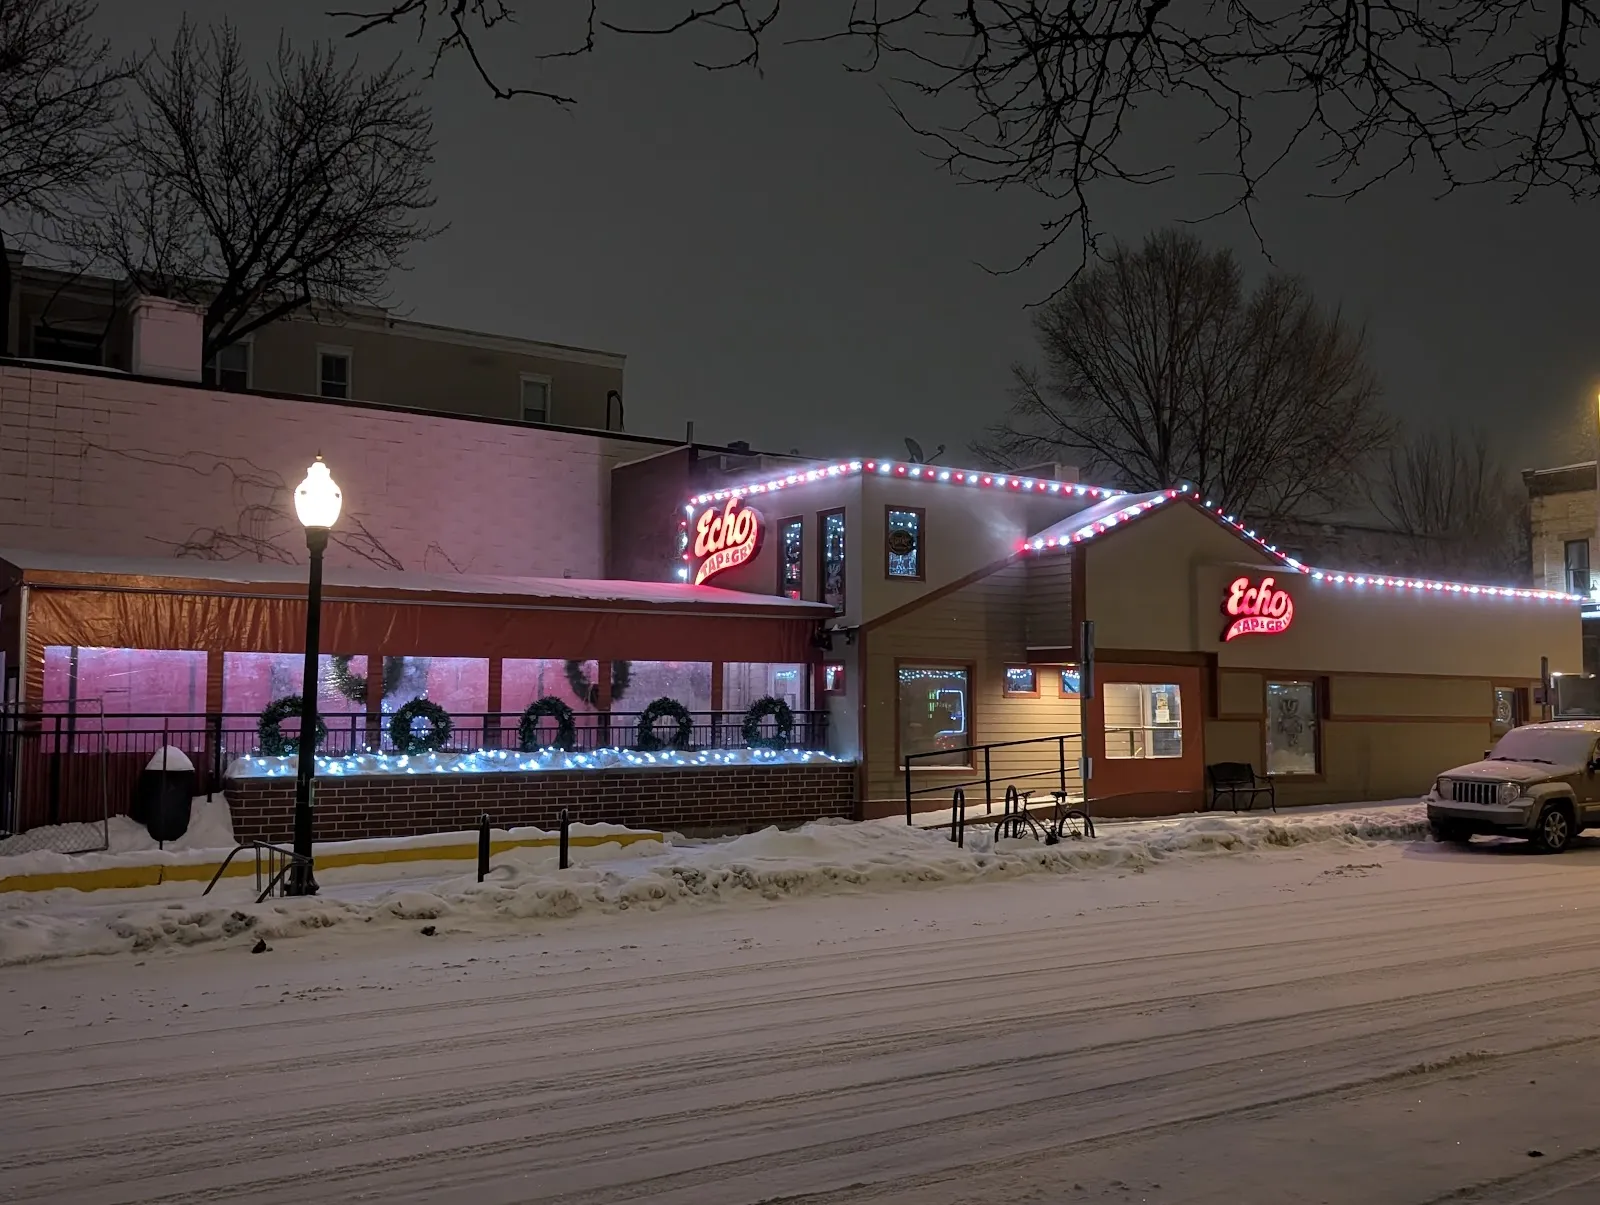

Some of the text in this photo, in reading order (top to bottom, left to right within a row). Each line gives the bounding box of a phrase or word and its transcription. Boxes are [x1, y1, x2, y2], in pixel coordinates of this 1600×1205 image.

[694, 497, 752, 557] Echo
[700, 551, 724, 576] TAP
[1227, 577, 1288, 617] Echo
[1234, 619, 1259, 633] TAP
